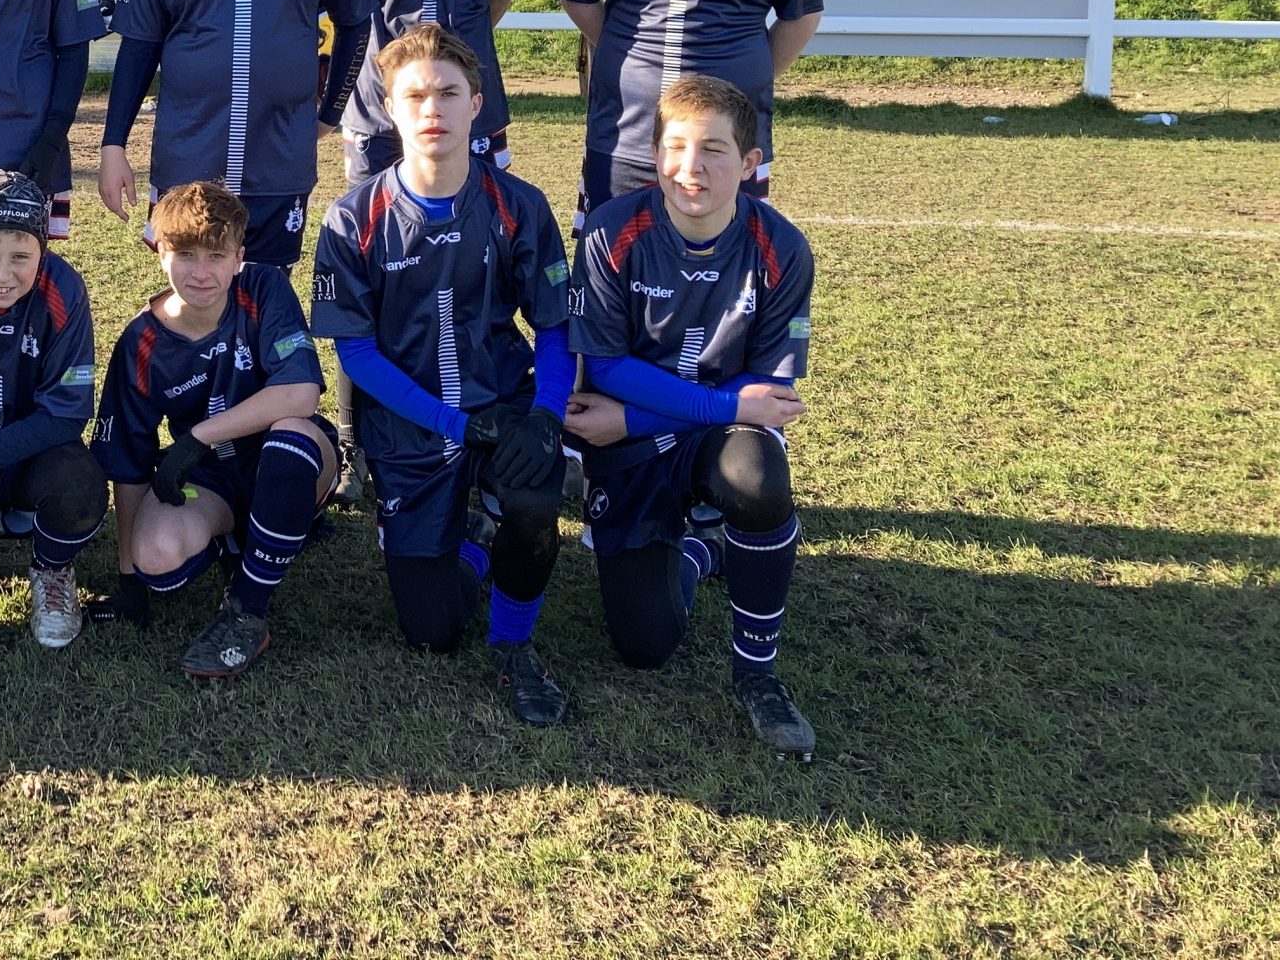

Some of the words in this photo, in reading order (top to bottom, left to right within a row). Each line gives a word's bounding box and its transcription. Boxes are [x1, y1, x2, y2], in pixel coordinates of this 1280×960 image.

[333, 33, 370, 111] BRIGHTON
[425, 231, 462, 246] VX3
[679, 269, 720, 282] VX3
[172, 371, 209, 396] Oander
